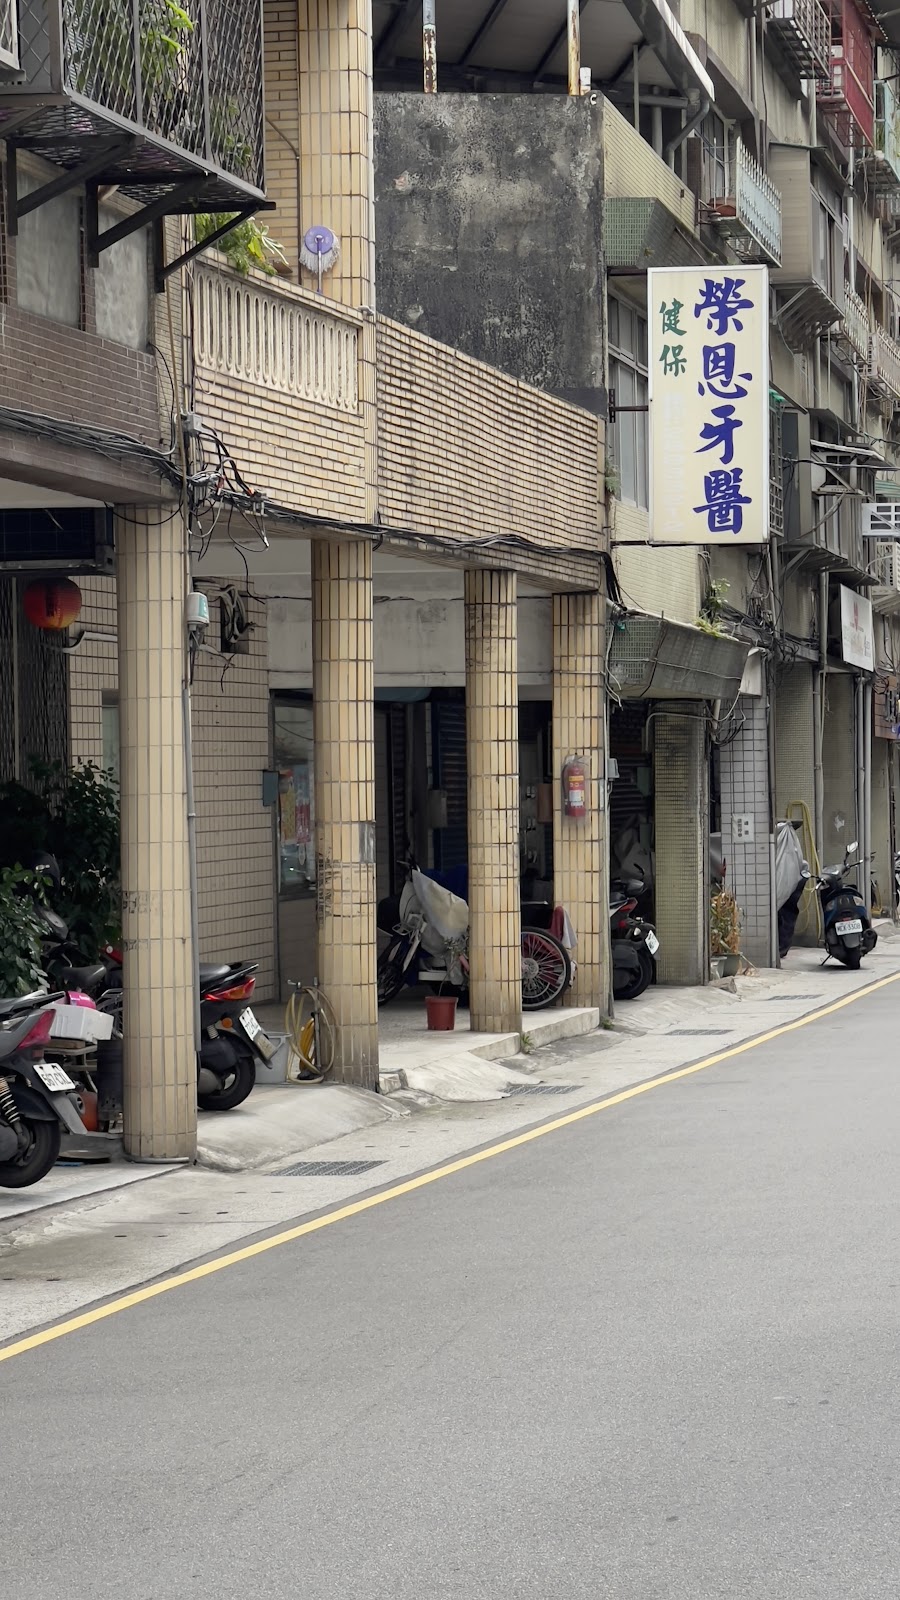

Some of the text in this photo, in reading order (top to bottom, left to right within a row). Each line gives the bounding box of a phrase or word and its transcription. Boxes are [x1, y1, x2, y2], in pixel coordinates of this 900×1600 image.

[659, 298, 688, 377] 健保
[694, 277, 754, 534] 榮恩牙醫
